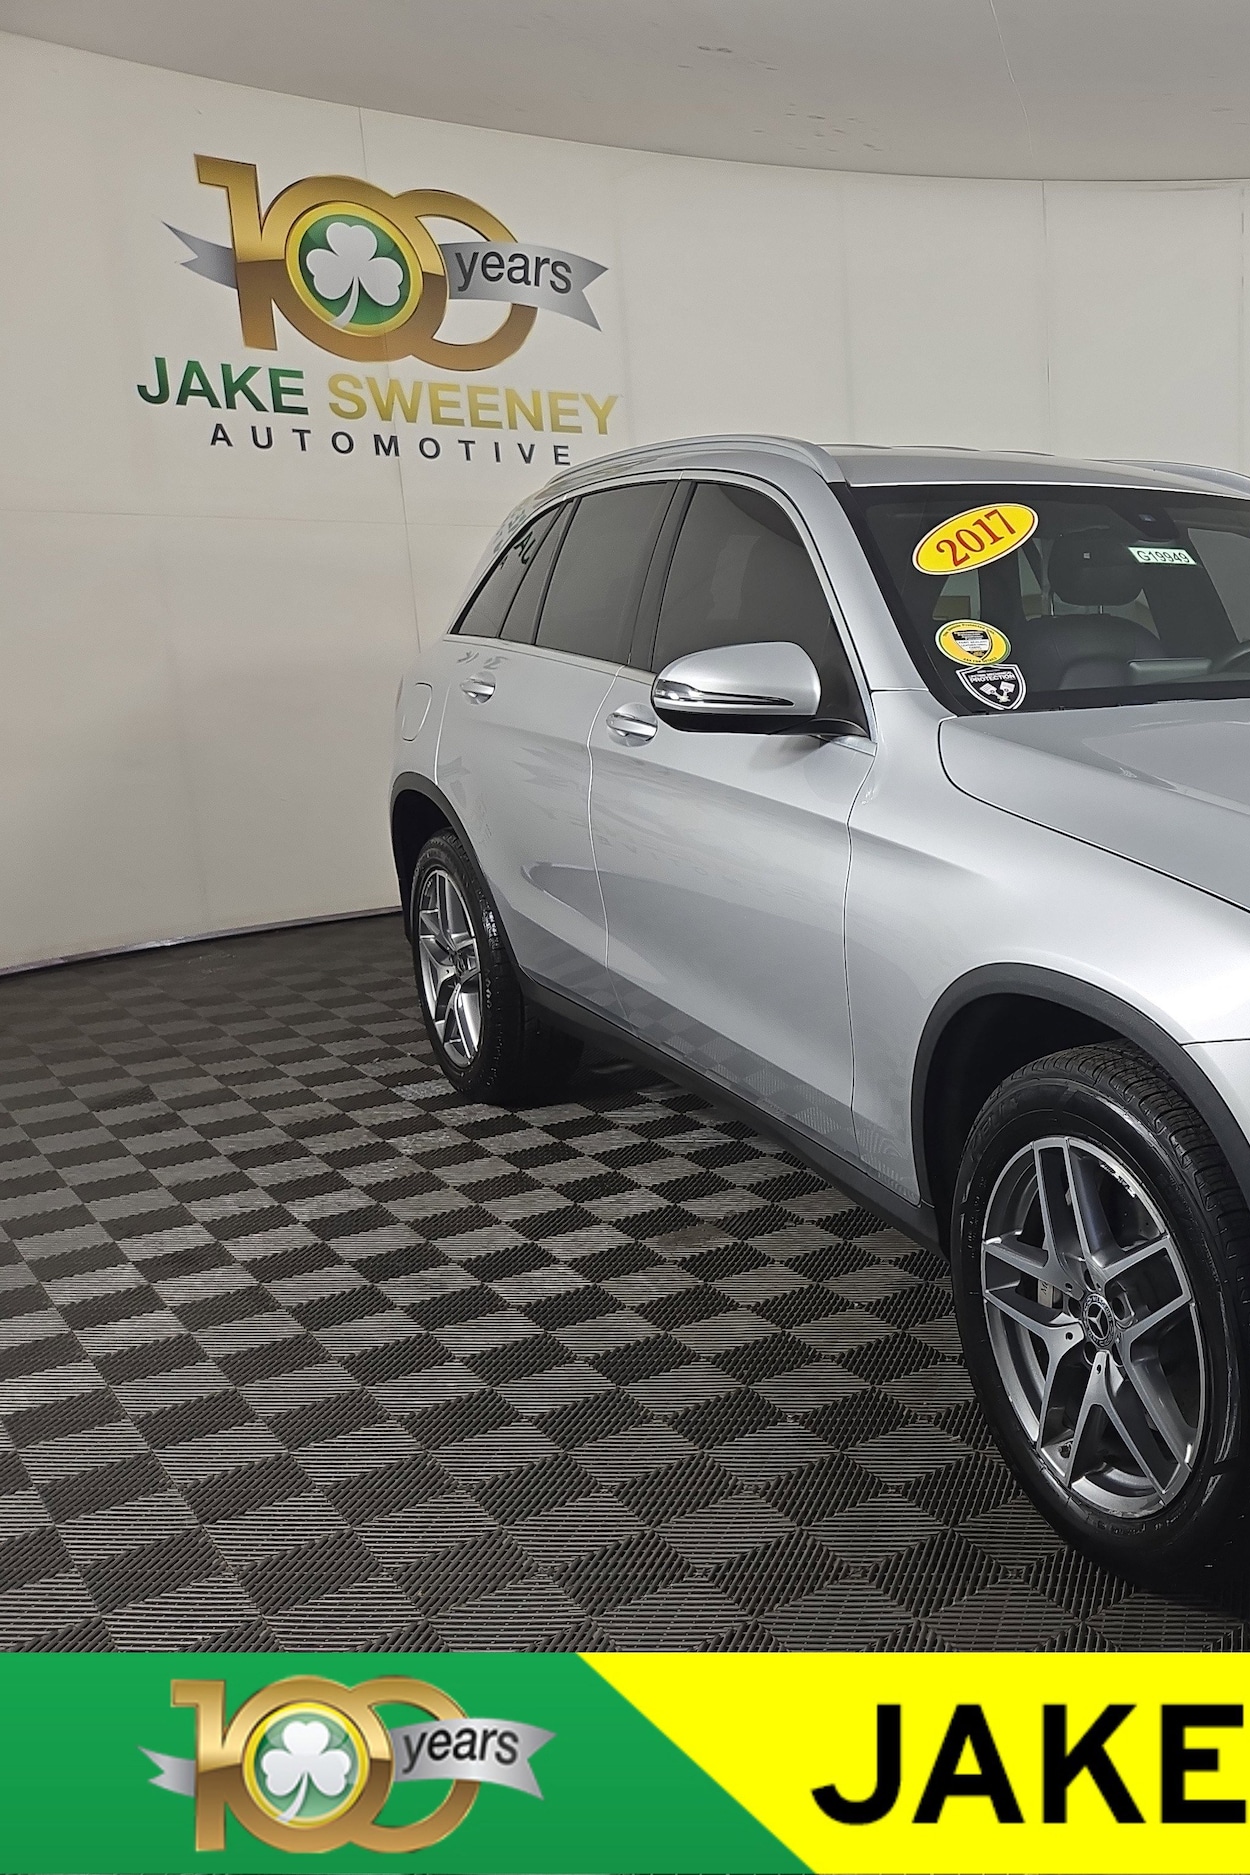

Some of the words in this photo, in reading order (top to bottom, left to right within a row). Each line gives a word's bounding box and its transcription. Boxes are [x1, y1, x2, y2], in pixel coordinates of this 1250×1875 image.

[194, 153, 538, 371] 100
[455, 250, 573, 294] years
[137, 356, 309, 415] JAKE
[328, 373, 619, 435] SWEENEY
[209, 422, 571, 466] AUTOMOTIVE
[936, 509, 1015, 567] 2017
[1136, 550, 1190, 563] G19949
